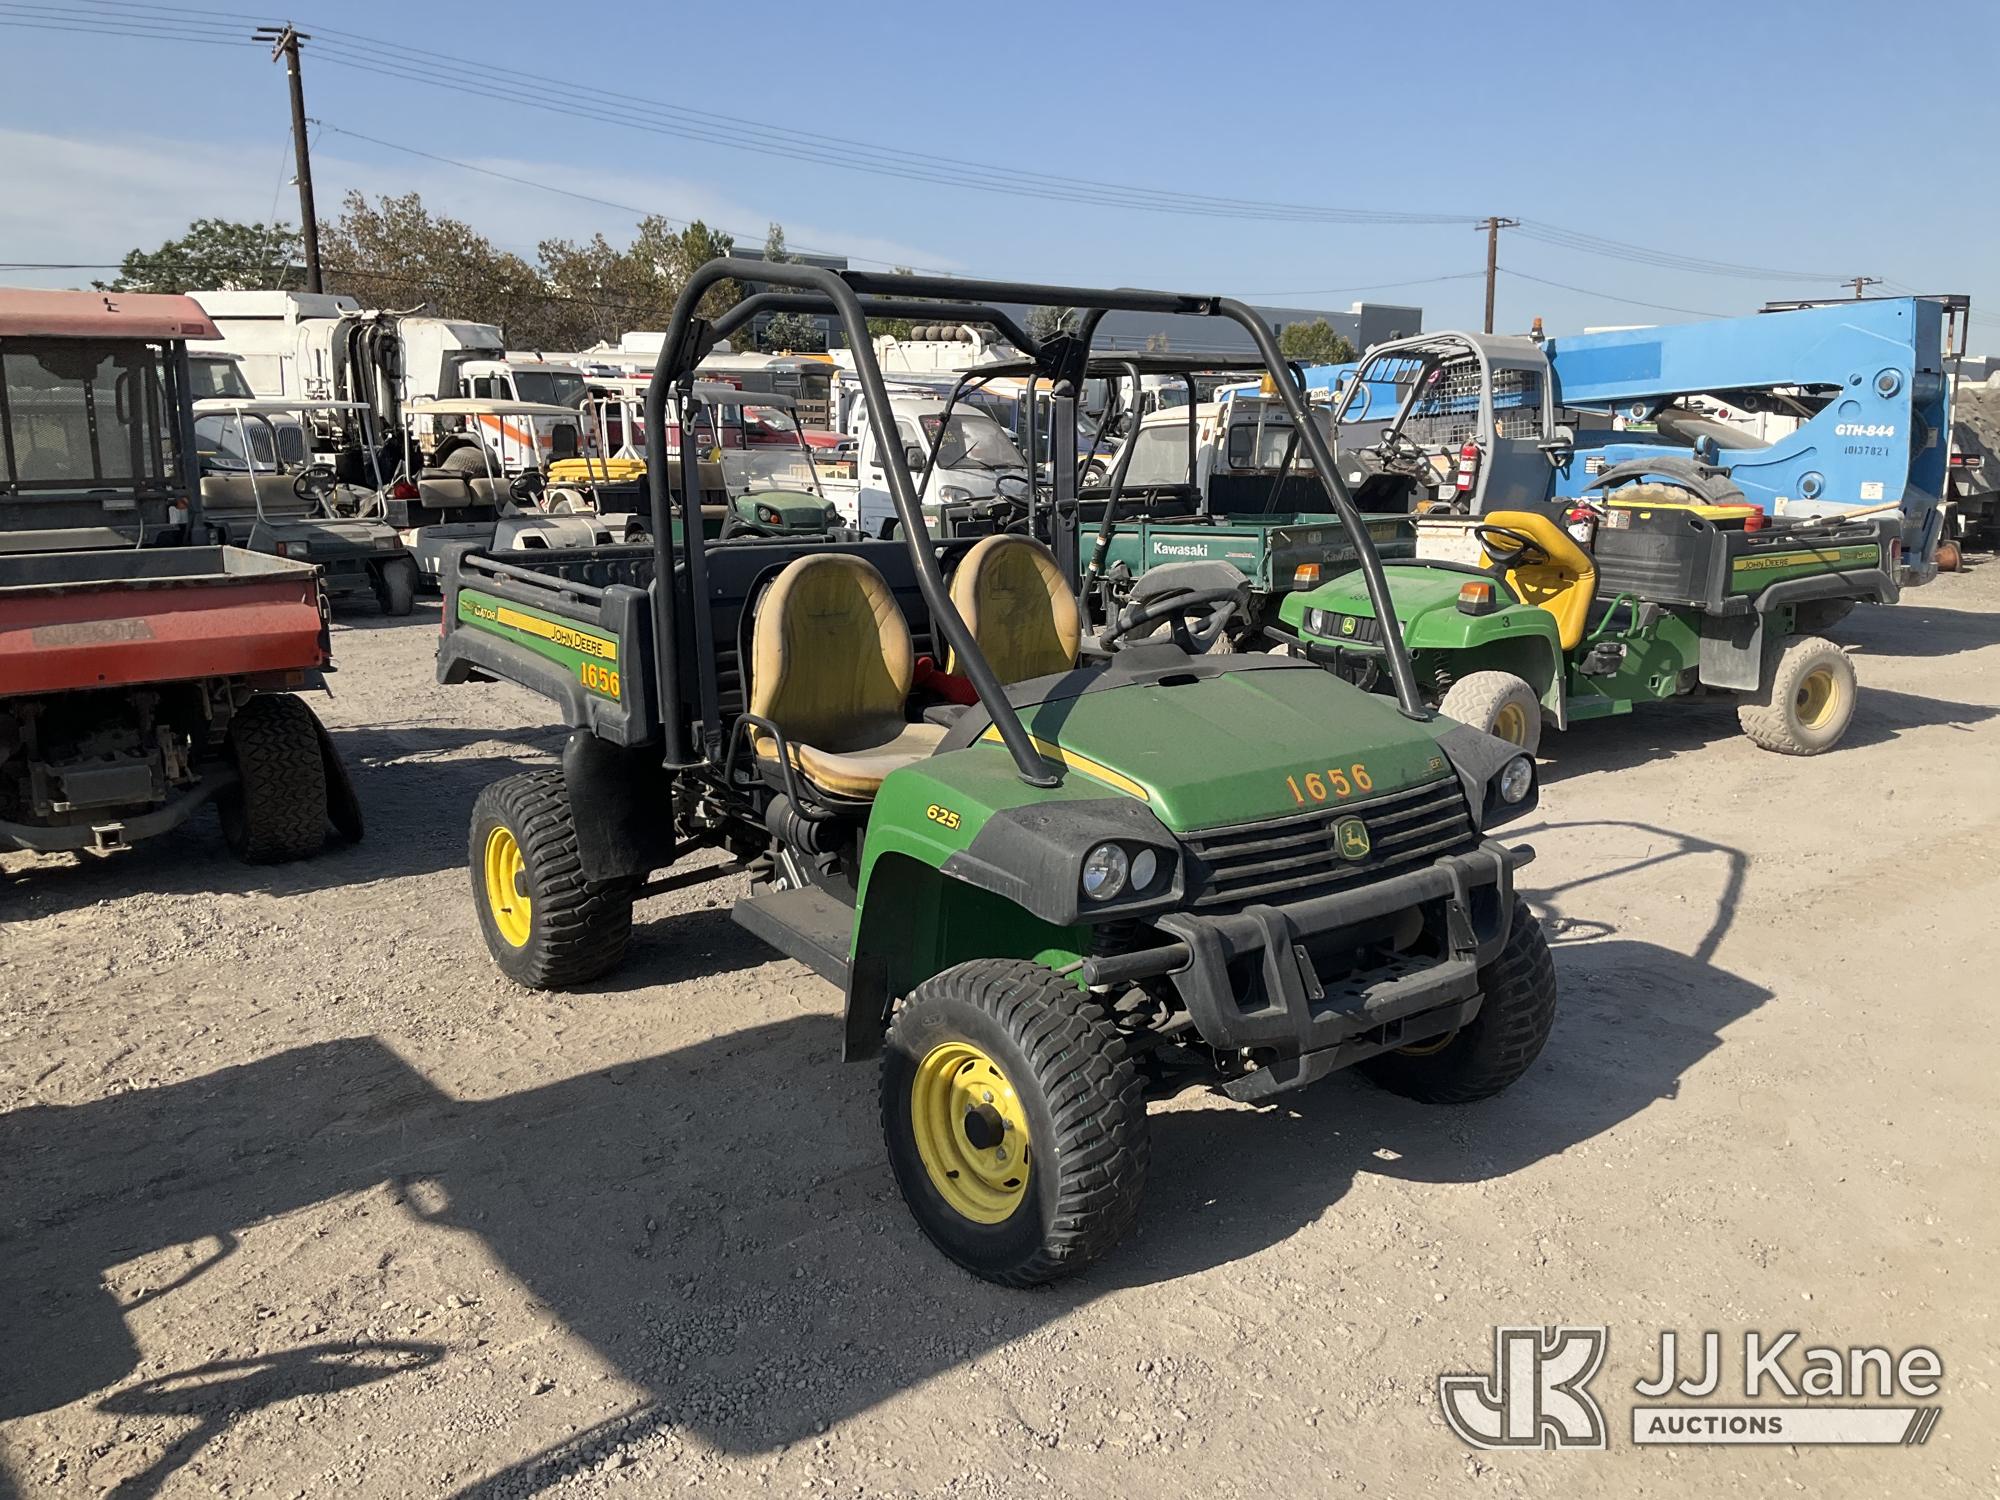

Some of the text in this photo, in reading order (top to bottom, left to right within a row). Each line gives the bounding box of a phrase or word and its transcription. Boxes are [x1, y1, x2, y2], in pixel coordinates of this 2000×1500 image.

[1834, 424, 1895, 437] GTH-844
[1153, 542, 1208, 557] Kawasaki
[1744, 558, 1789, 569] JOHN DEERE
[474, 604, 497, 621] GATOR
[551, 627, 604, 656] JOHN DEERE
[580, 661, 621, 697] 1656
[1286, 763, 1374, 808] 1656
